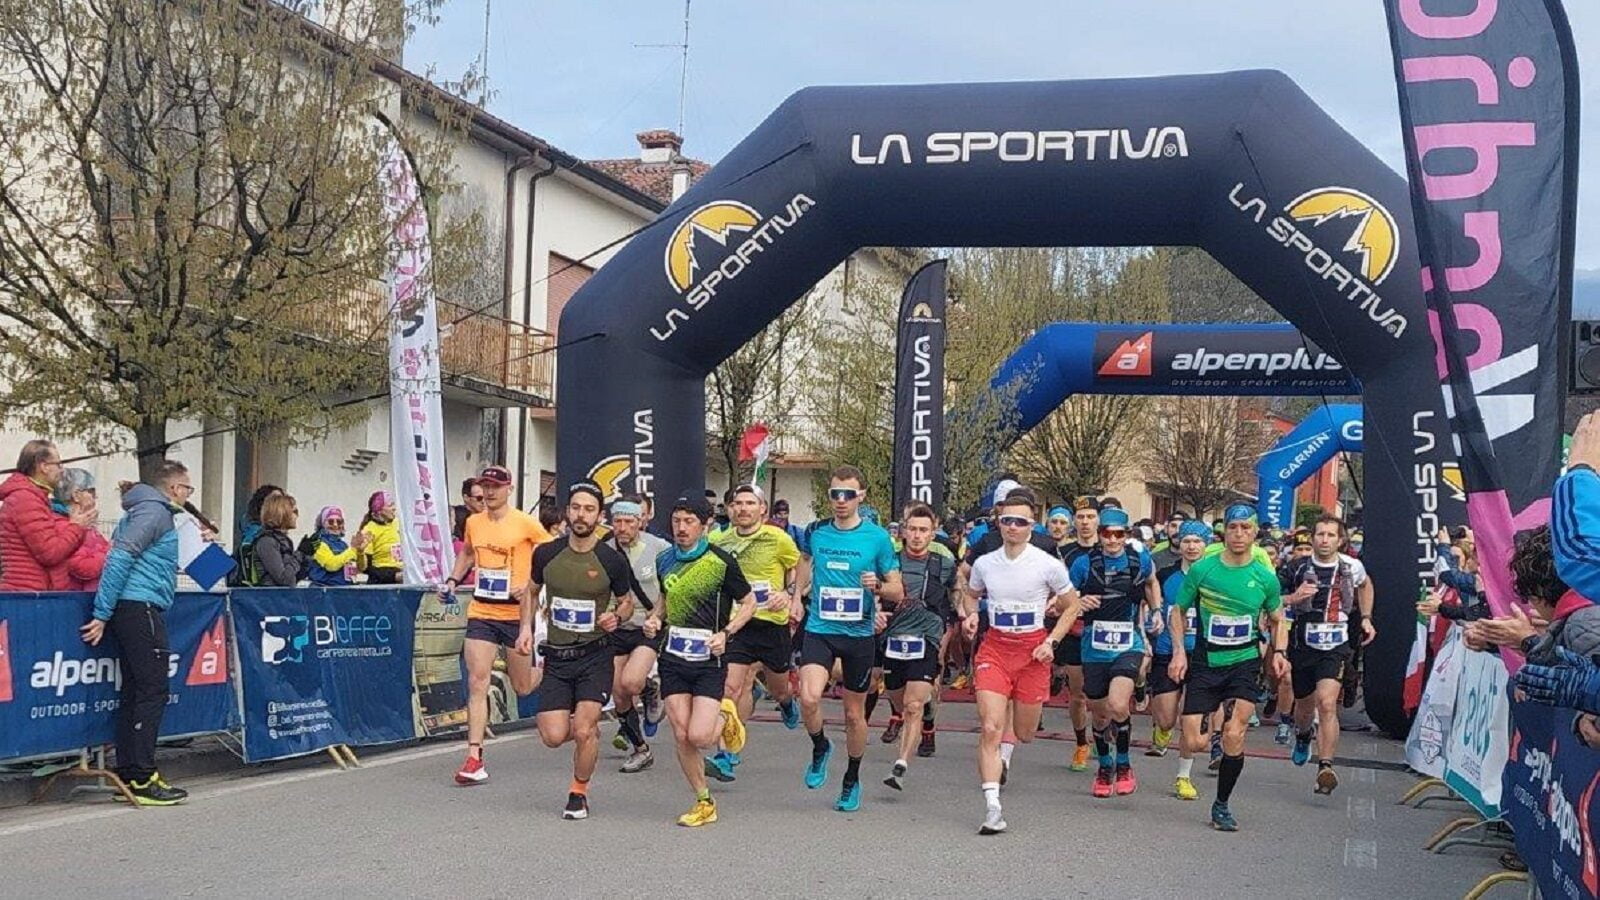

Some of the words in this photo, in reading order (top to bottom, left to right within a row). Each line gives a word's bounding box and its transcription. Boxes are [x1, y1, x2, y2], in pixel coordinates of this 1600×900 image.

[852, 133, 912, 165] LA
[926, 126, 1189, 164] SPORTIVA
[649, 308, 690, 341] LA
[685, 193, 817, 312] SPORTIVA
[1228, 182, 1268, 223] LA
[1266, 216, 1408, 339] SPORTIVA
[1171, 347, 1343, 377] alpenplus
[1240, 379, 1279, 387] SPORT
[911, 335, 933, 506] SPORTIVA
[1413, 410, 1436, 455] LA
[1279, 431, 1331, 480] GARMIN
[633, 408, 655, 519] RTIVA
[1414, 463, 1439, 597] SPORT
[487, 578, 495, 591] 7
[836, 599, 845, 612] 6
[568, 610, 577, 623] 3
[1010, 615, 1019, 627] 1
[1104, 632, 1122, 645] 49
[1226, 626, 1236, 637] 4
[1318, 632, 1334, 644] 34
[684, 639, 693, 652] 2
[901, 641, 909, 654] 9
[30, 701, 86, 719] OUTDOOR
